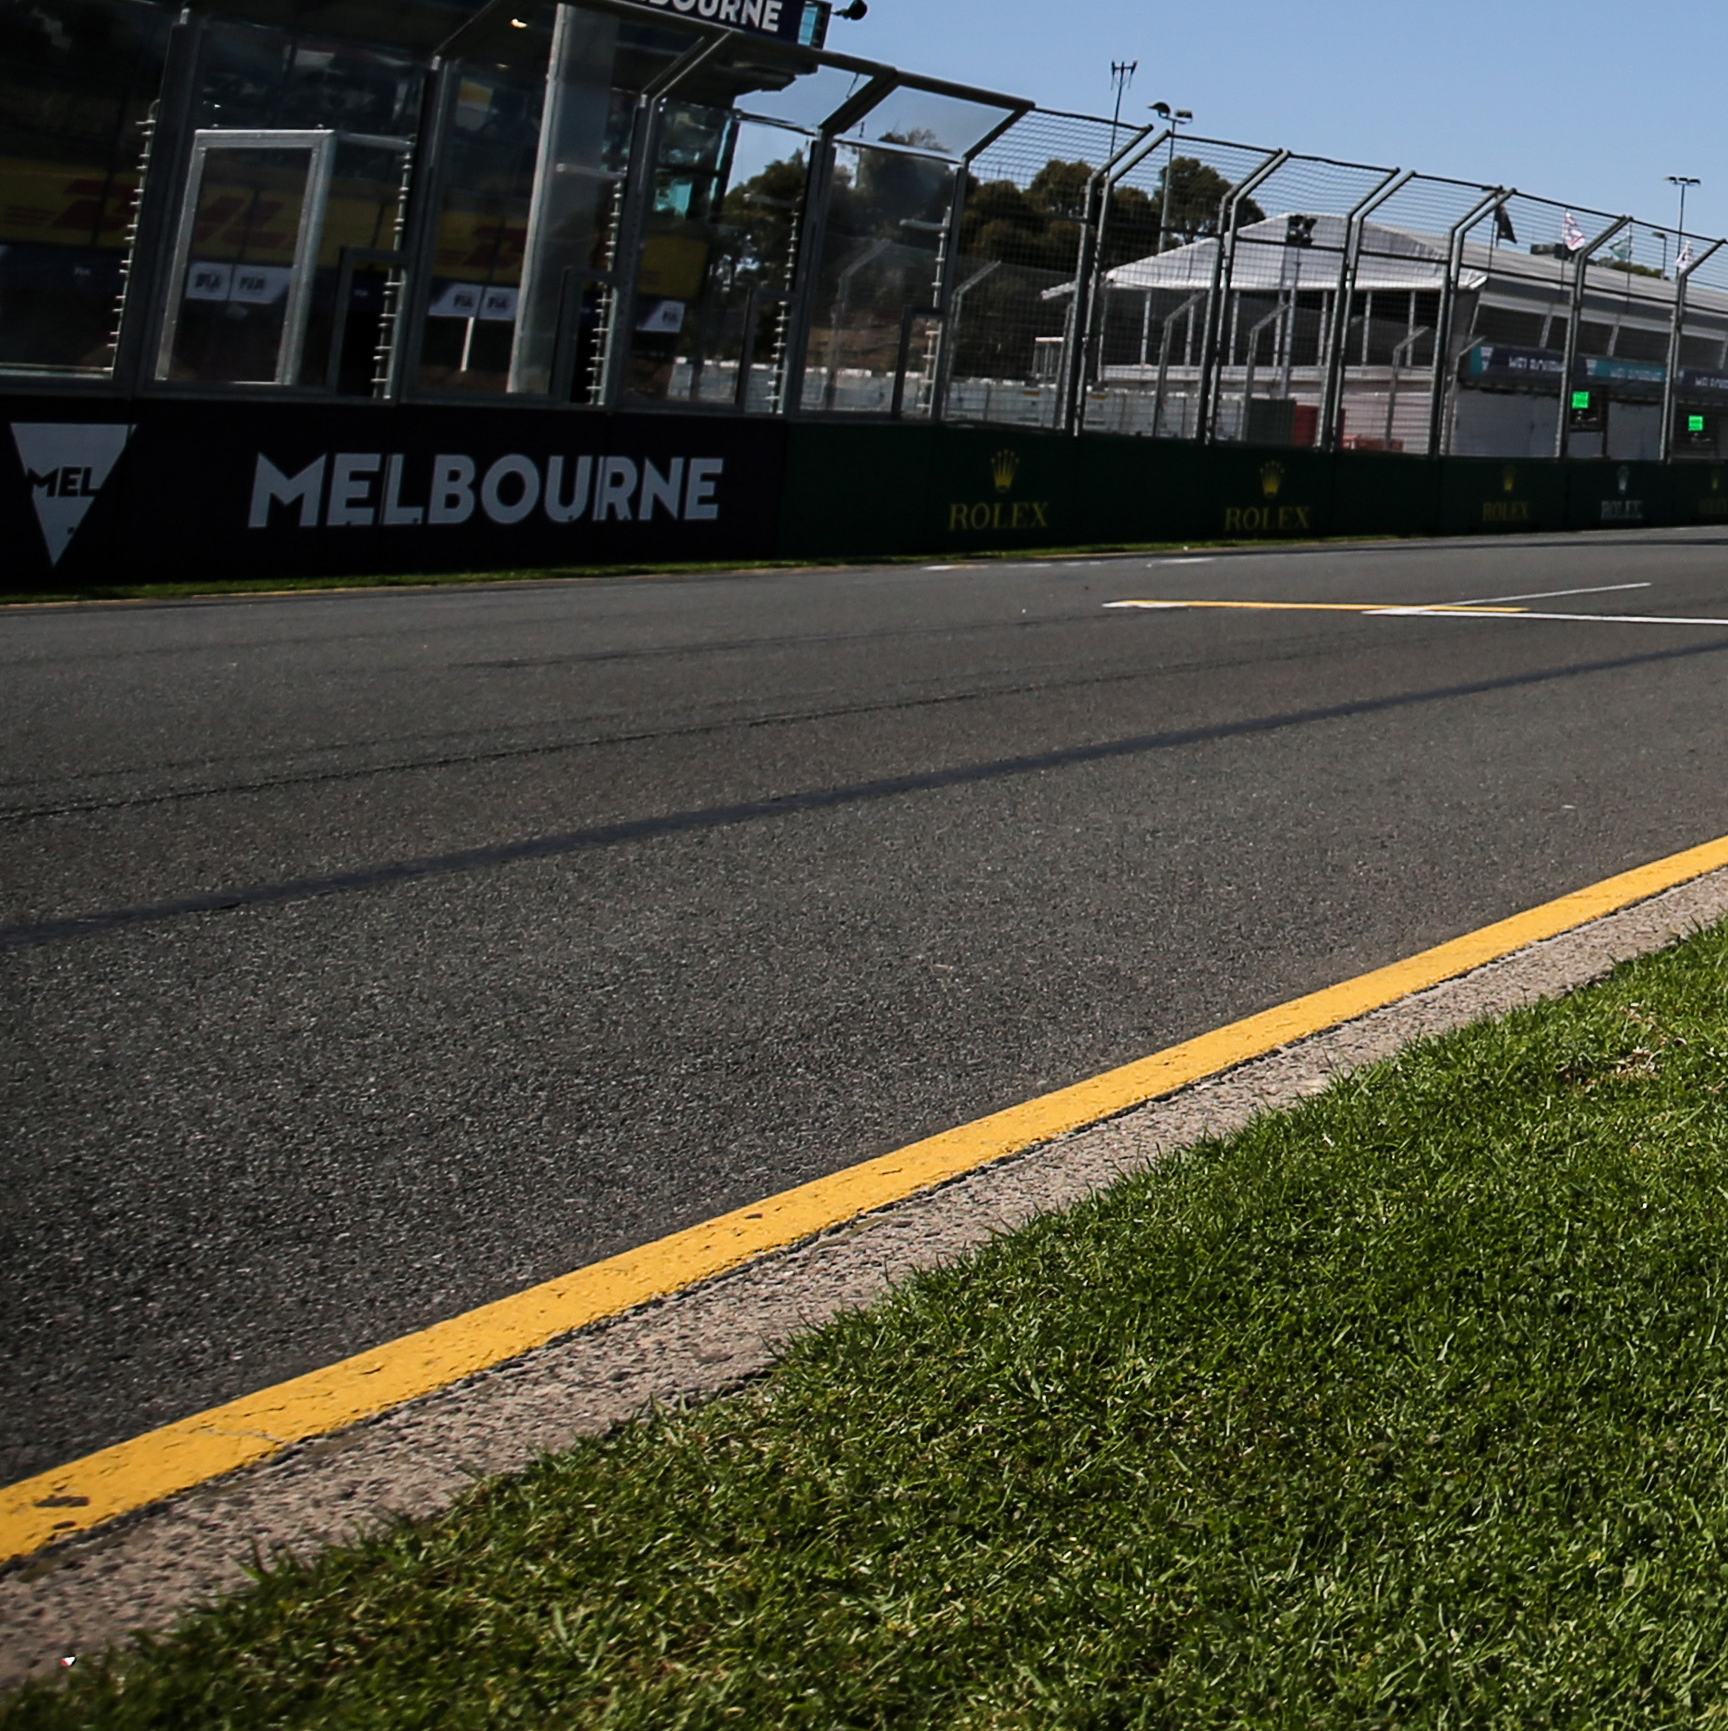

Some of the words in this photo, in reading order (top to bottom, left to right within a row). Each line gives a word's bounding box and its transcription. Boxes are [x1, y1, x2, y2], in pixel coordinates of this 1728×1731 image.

[25, 466, 102, 498] MEL
[248, 452, 724, 529] MELBOURNE
[948, 501, 1049, 532] ROLEX
[1224, 505, 1312, 532] ROLEX
